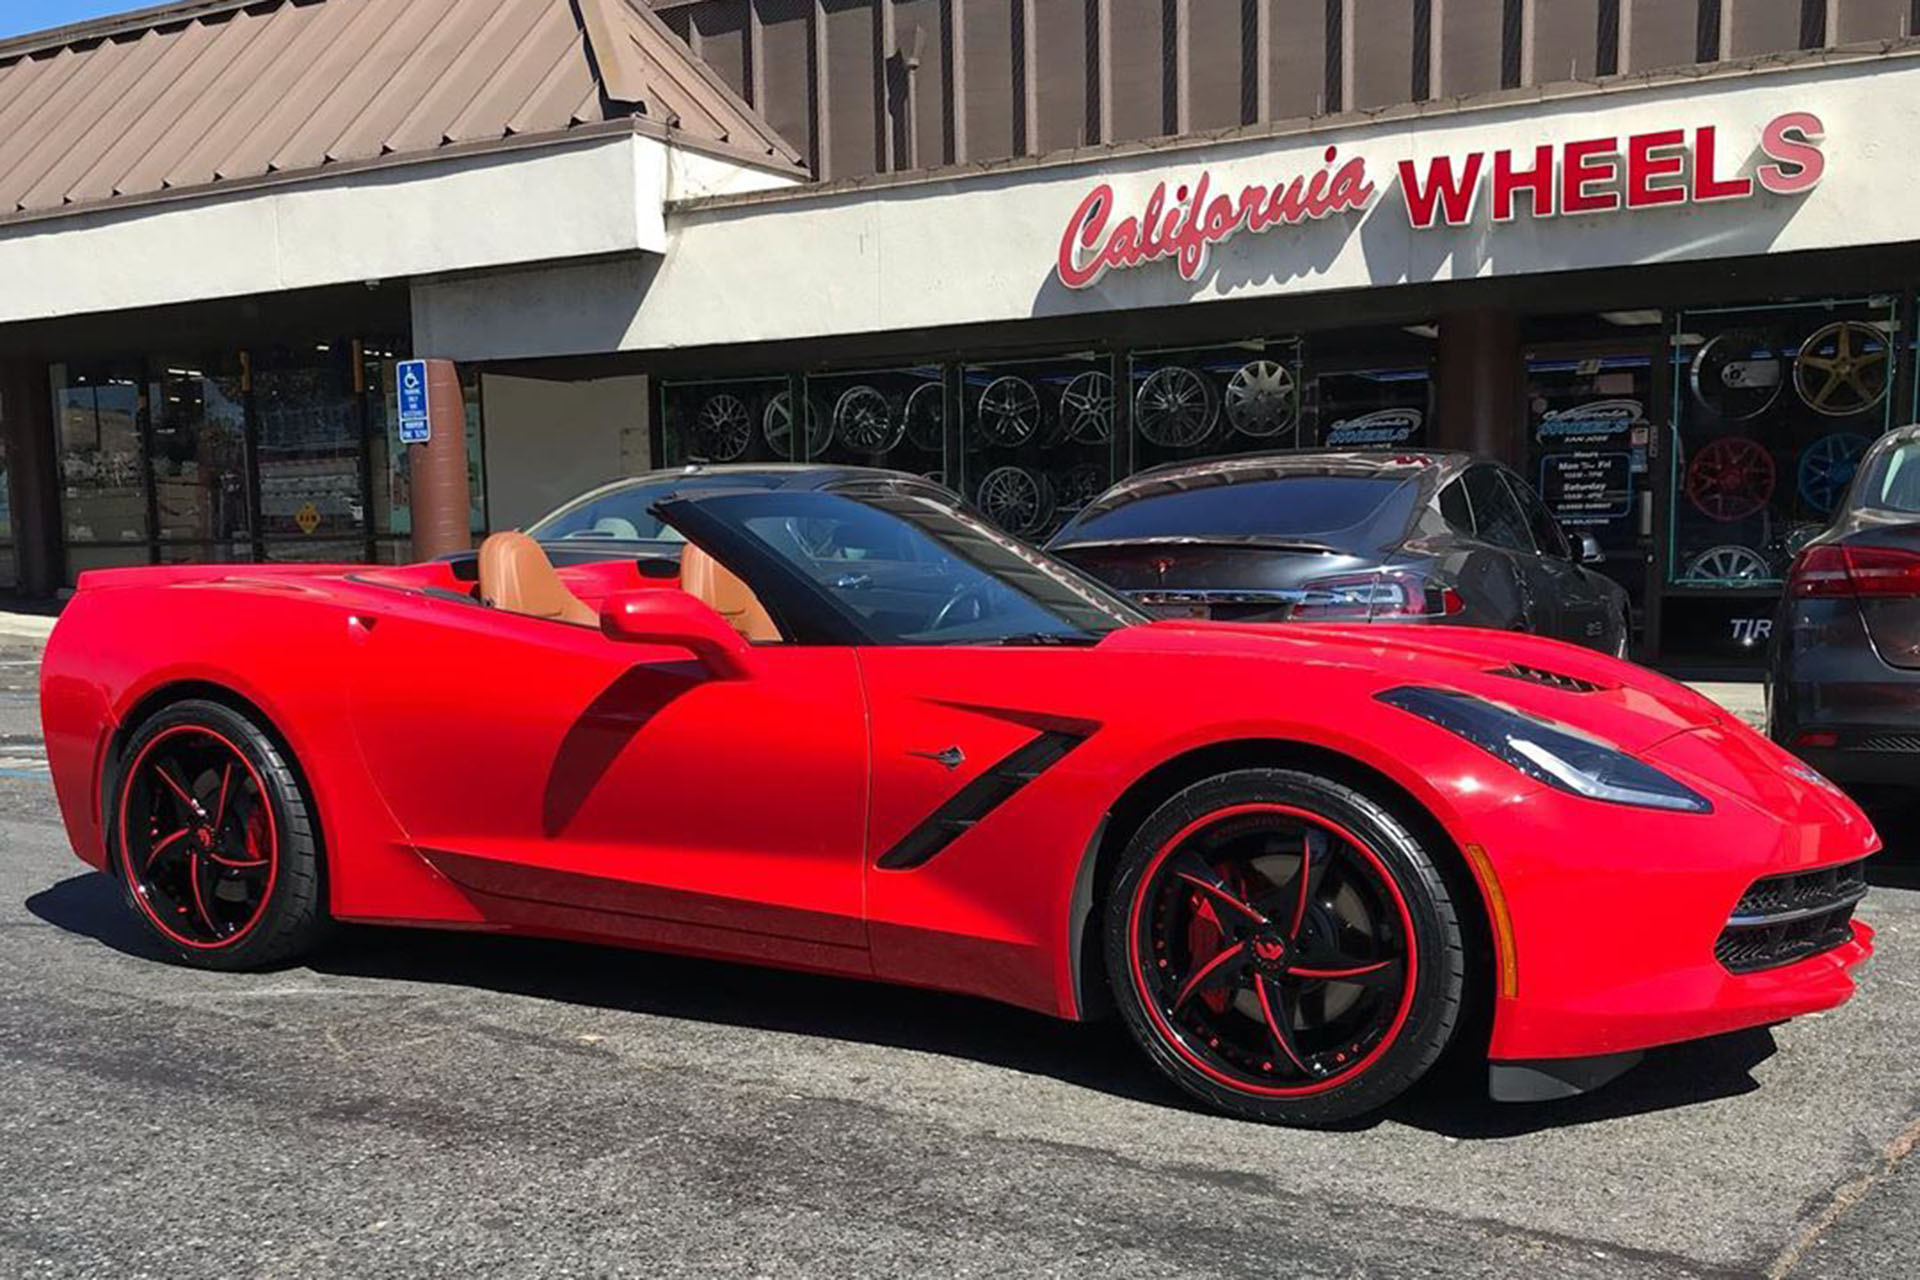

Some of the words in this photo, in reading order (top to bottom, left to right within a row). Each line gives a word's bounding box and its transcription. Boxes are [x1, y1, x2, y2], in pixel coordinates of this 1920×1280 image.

[1058, 146, 1375, 289] California
[1398, 112, 1826, 229] WHEELS
[1558, 462, 1579, 470] Mon
[1563, 482, 1606, 492] Saturday
[1730, 618, 1773, 639] TIR
